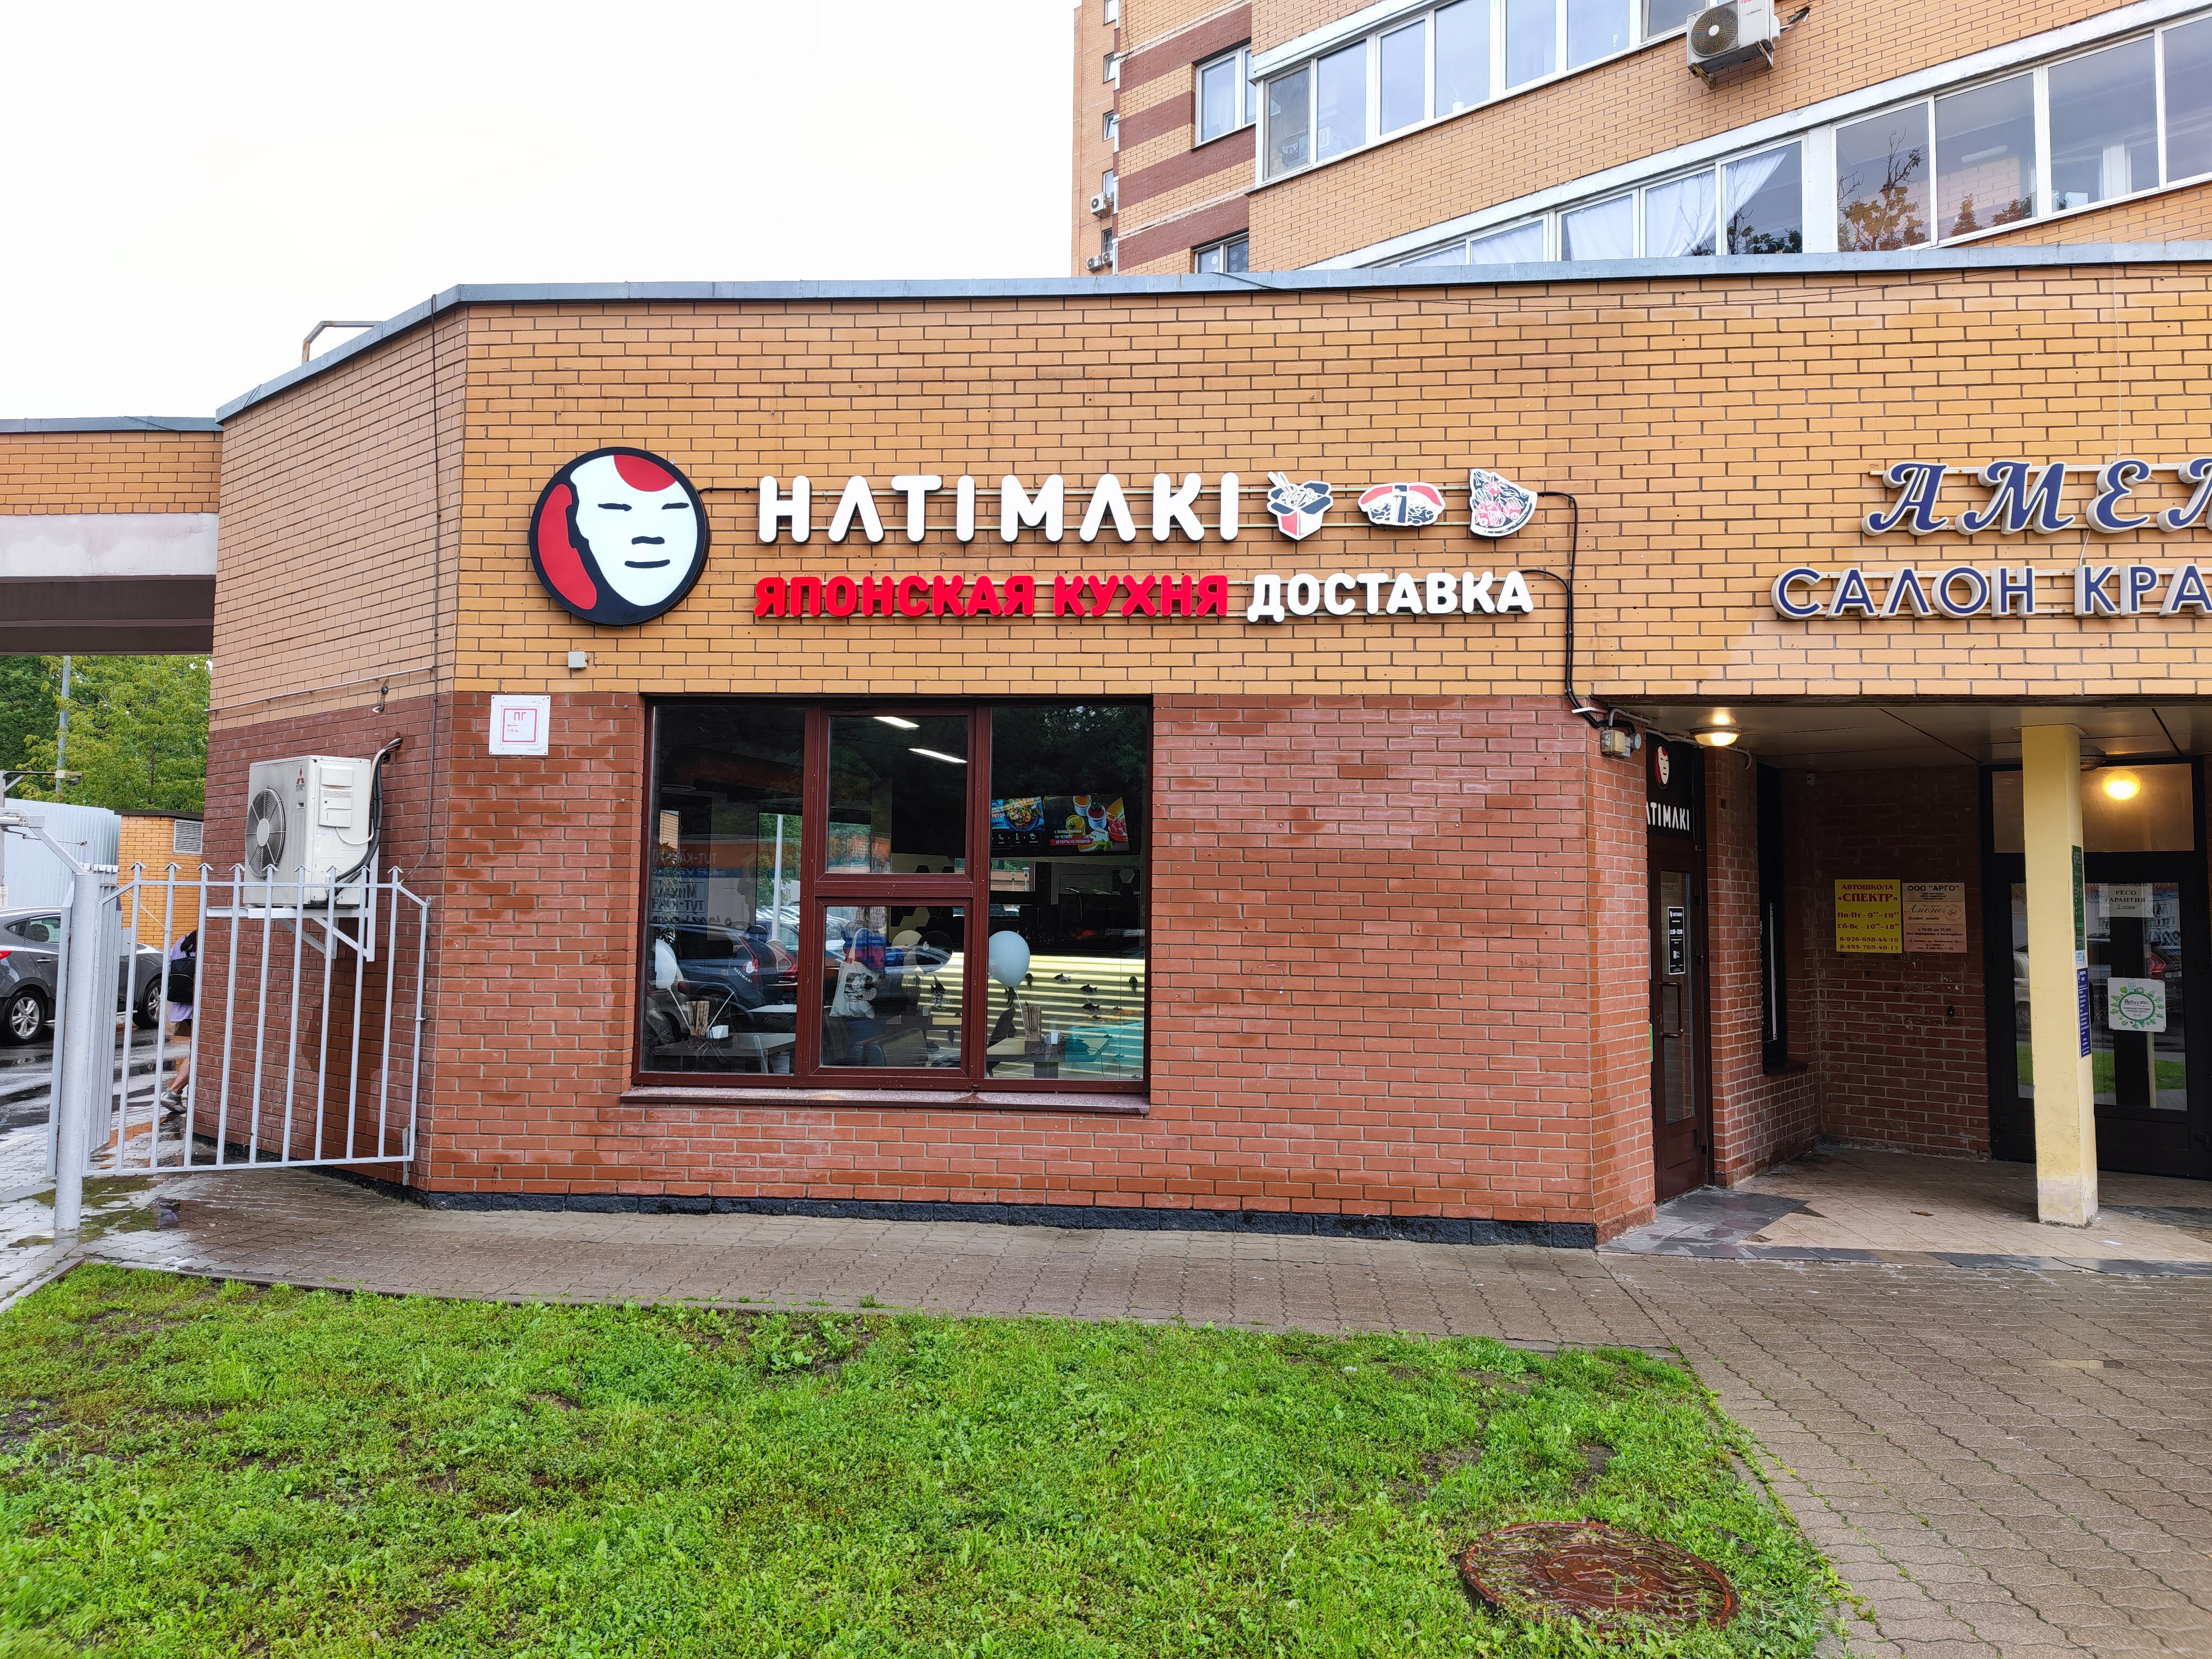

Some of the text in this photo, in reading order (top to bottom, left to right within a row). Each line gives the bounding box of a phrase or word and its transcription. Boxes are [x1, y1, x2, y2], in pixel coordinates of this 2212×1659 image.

[755, 575, 1229, 618] ЯПОНСКАЯ КУХНЯ
[1248, 571, 1534, 623] ДОСТАВКА
[1771, 564, 2212, 619] САЛОН КРА
[514, 712, 526, 721] ПГ
[1838, 893, 1898, 902] «СПЕКТР»
